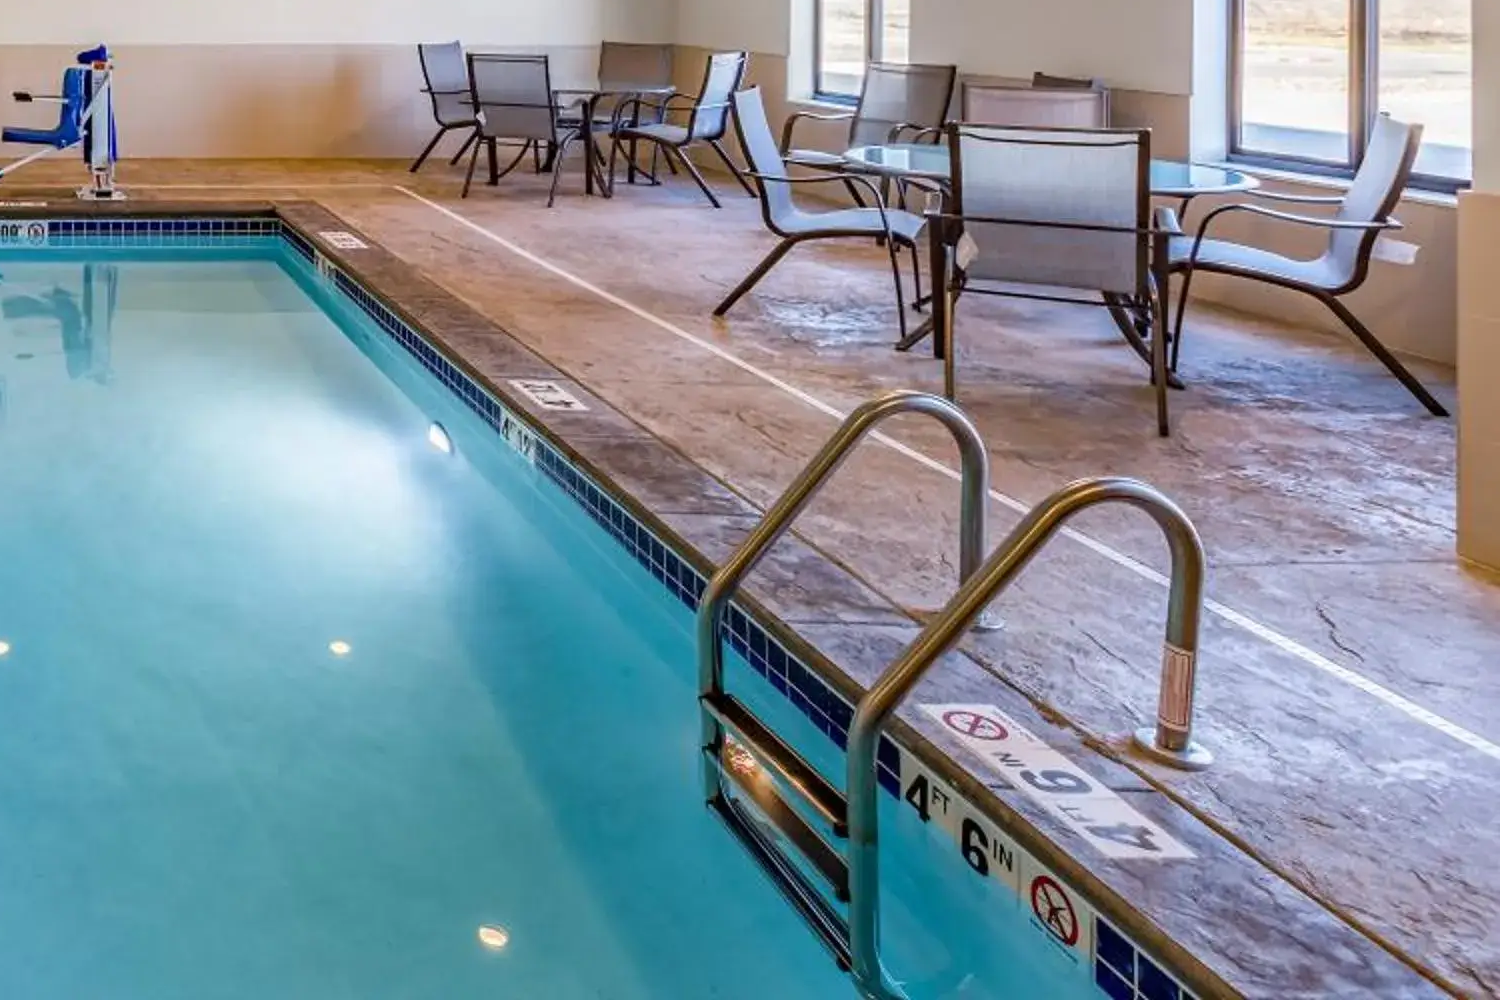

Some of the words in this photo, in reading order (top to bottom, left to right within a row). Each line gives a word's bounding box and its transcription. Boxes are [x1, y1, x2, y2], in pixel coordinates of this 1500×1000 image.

[1020, 769, 1092, 794] 6
[905, 775, 931, 823] 4
[931, 789, 950, 815] FT
[962, 817, 989, 877] 6
[993, 839, 1013, 872] IN
[1085, 822, 1163, 851] 4
